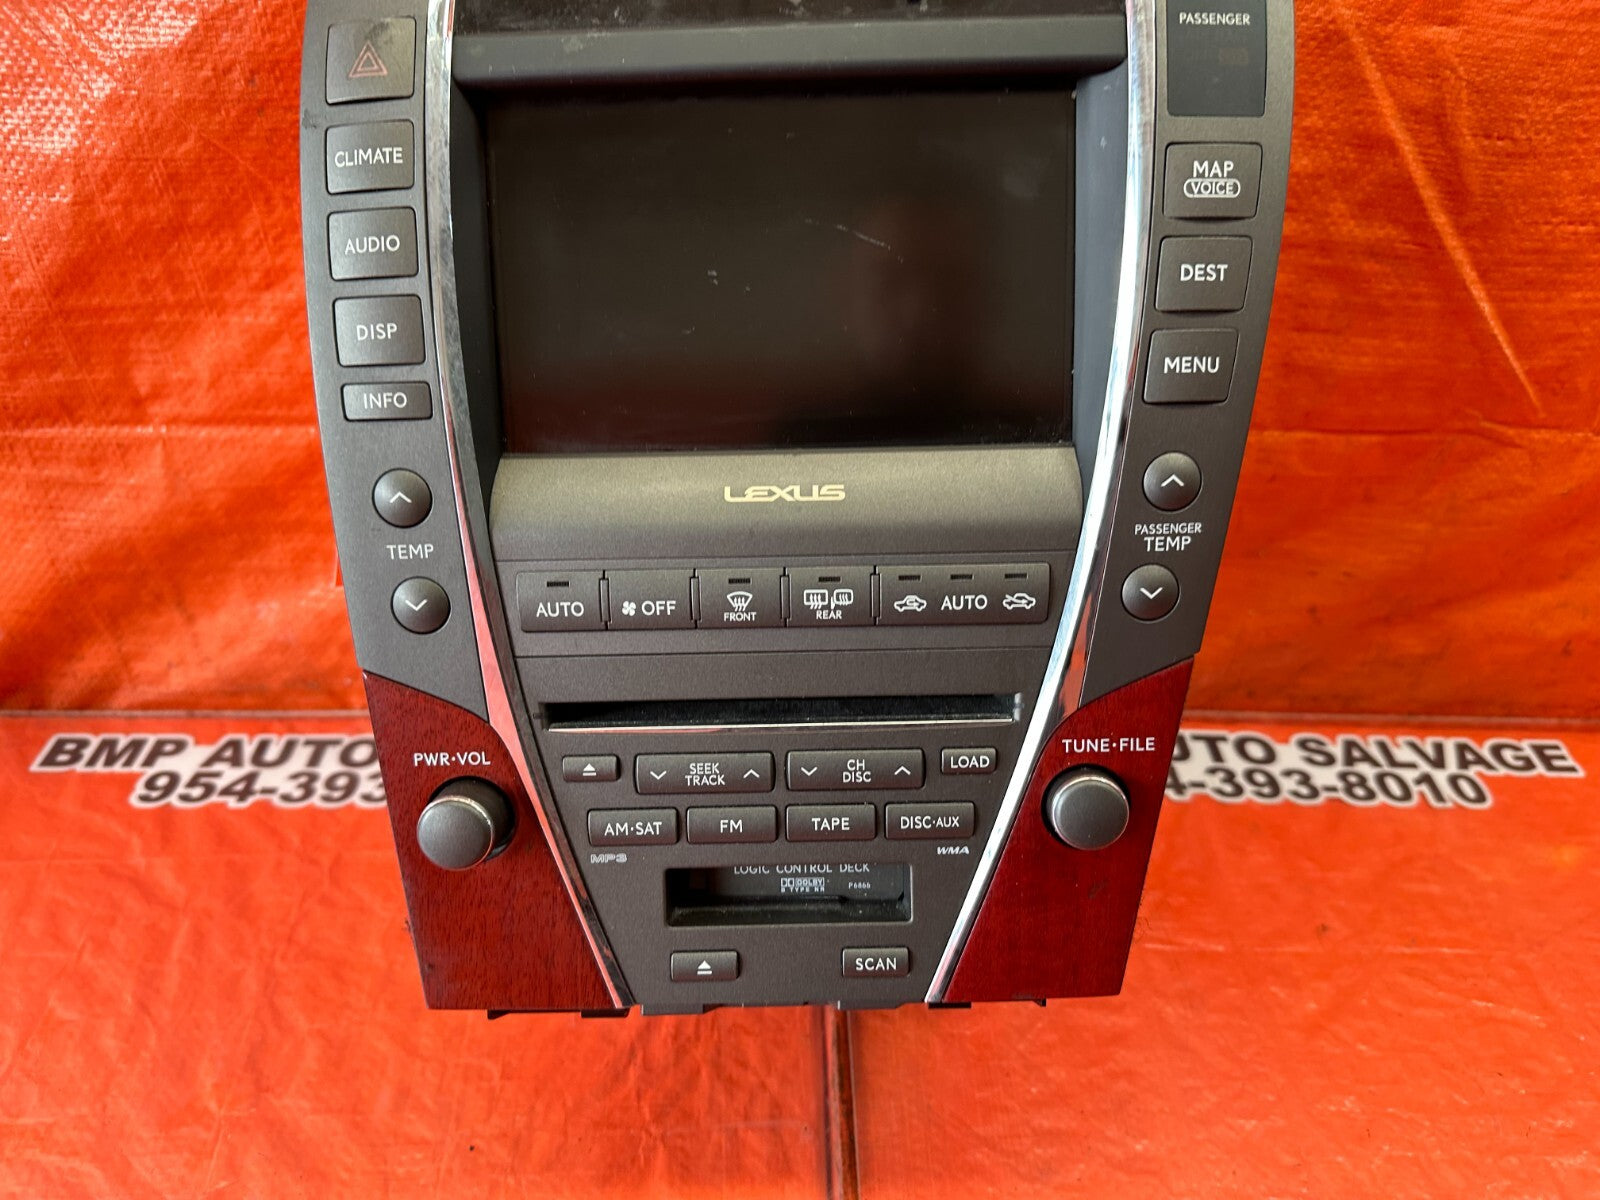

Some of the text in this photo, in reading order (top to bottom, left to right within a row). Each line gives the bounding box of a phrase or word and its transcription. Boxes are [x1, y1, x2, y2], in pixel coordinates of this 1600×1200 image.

[1179, 12, 1251, 26] PASSENGER
[334, 147, 404, 168] CLIMATE
[1192, 160, 1234, 178] MAP
[1191, 181, 1235, 196] VOICE
[344, 234, 401, 255] AUDIO
[1180, 263, 1229, 282] DEST
[356, 323, 398, 341] DISP
[1163, 356, 1220, 374] MENU
[362, 392, 408, 409] INFO
[724, 484, 846, 503] LEXUS
[1134, 522, 1202, 535] PASSENGER
[1143, 535, 1192, 552] TEMP
[386, 543, 434, 560] TEMP
[536, 601, 585, 618] AUTO
[641, 600, 677, 616] OFF
[940, 594, 988, 611] AUTO
[723, 611, 757, 622] FRONT
[815, 607, 842, 620] REAR
[37, 735, 379, 770] BMP AUTO
[1299, 735, 1578, 774] SALVAGE
[689, 762, 719, 775] SEEK
[846, 758, 866, 771] CH
[950, 755, 990, 769] LOAD
[684, 774, 726, 786] TRACK
[842, 771, 872, 783] DISC
[719, 819, 743, 833] FM
[811, 817, 850, 831] TAPE
[936, 845, 970, 855] WMA
[590, 853, 628, 864] MP3
[839, 863, 870, 873] DECK
[794, 877, 825, 887] DOLBY
[855, 957, 897, 971] SCAN
